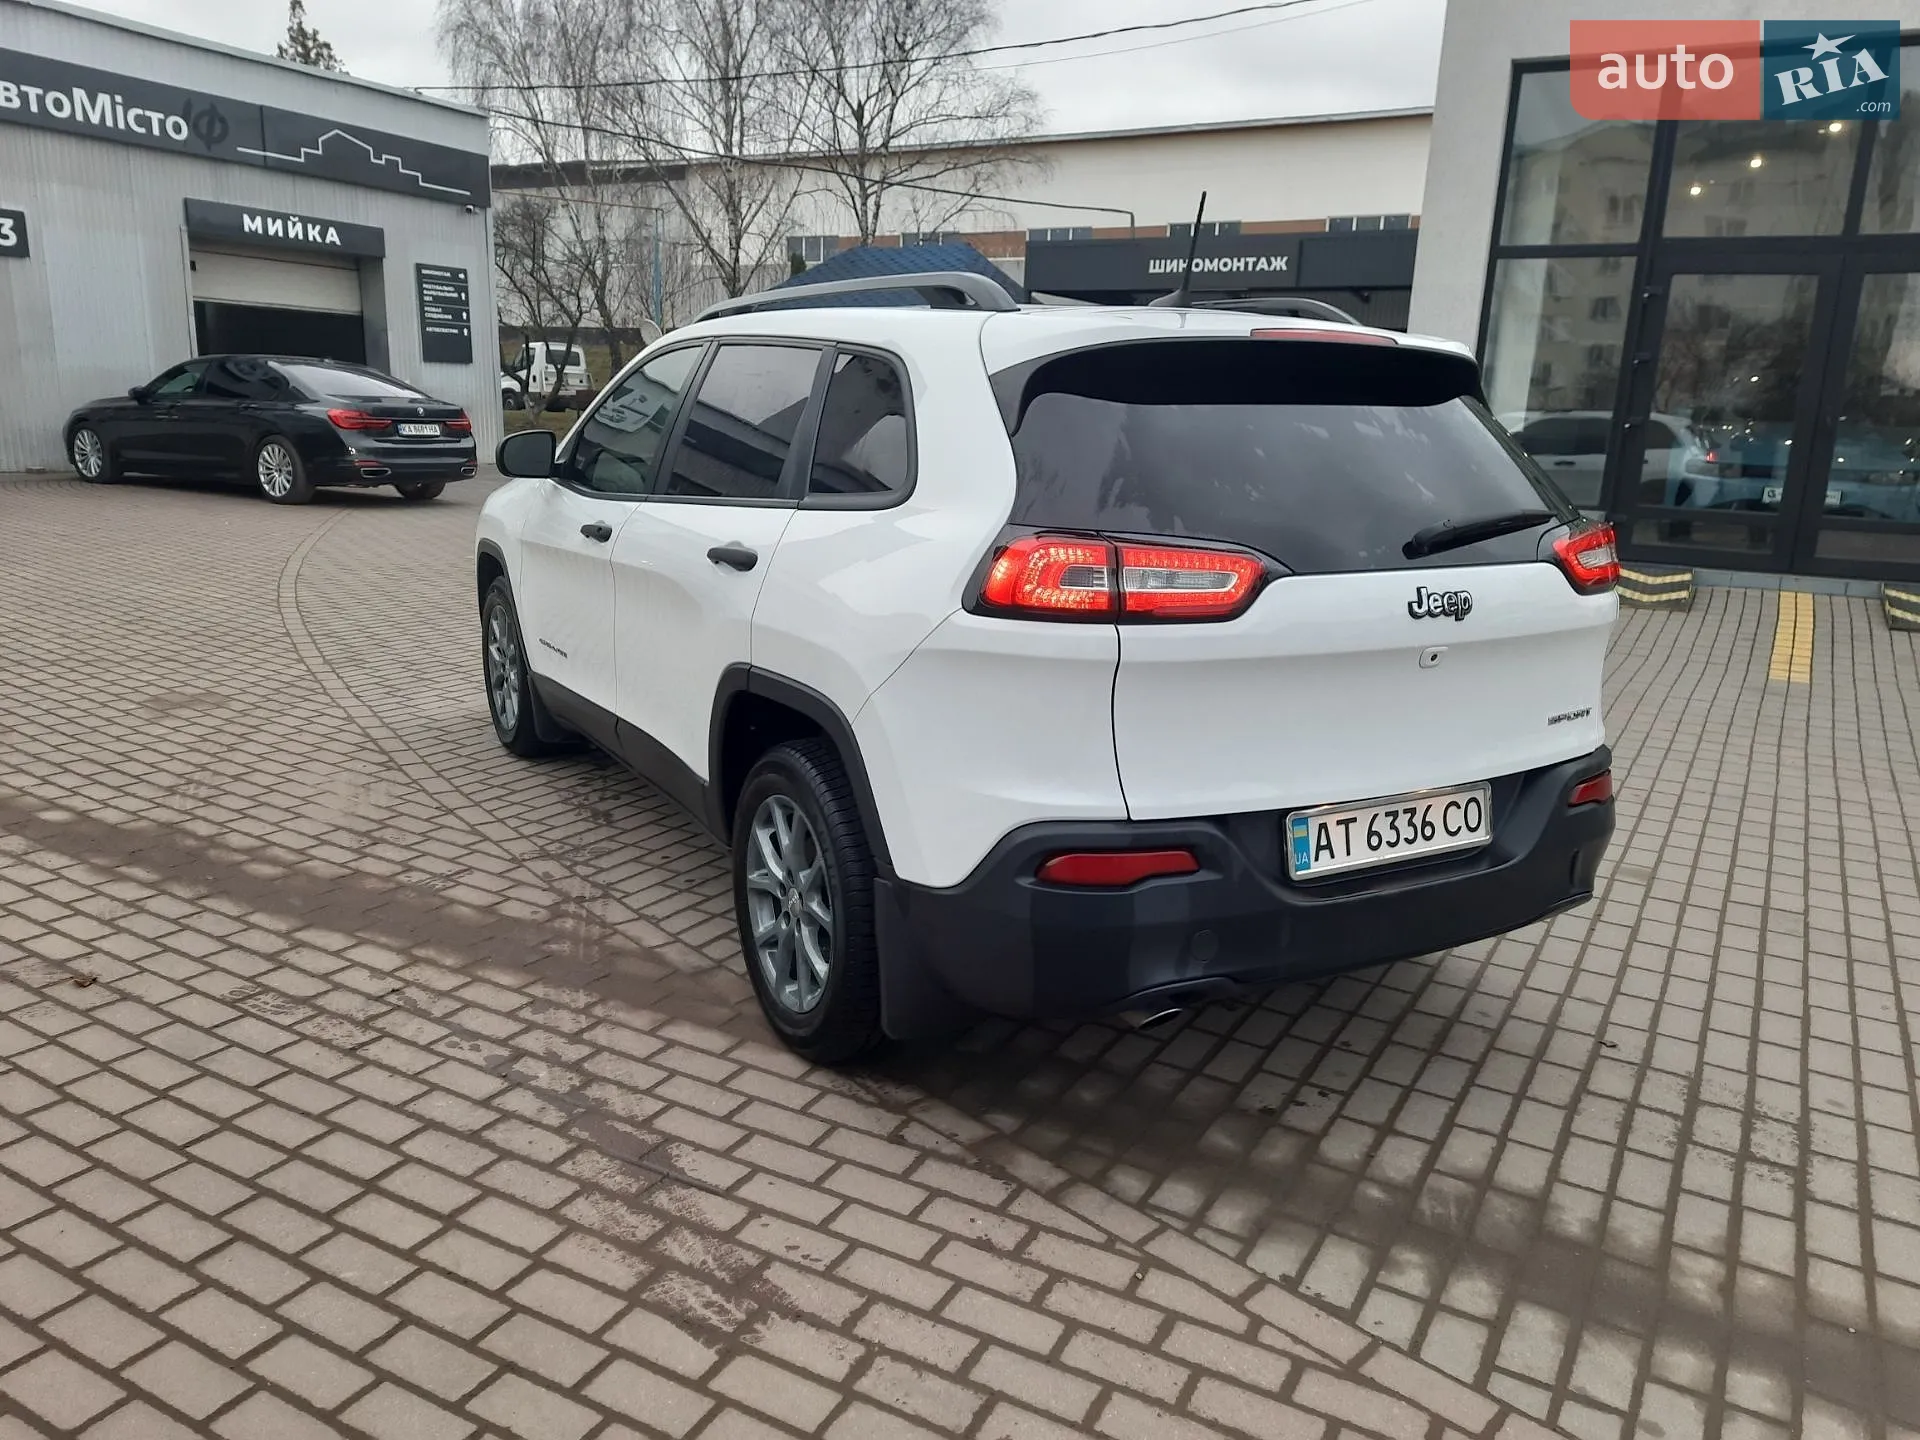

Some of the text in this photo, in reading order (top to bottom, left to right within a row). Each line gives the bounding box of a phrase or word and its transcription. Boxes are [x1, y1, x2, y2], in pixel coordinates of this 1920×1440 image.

[242, 213, 342, 246] МИЙКА
[1148, 256, 1289, 274] ШИНОМОНТАЖ
[1408, 586, 1473, 621] Jeep
[1314, 796, 1483, 862] AT 6336 CO
[1295, 852, 1309, 865] UA
